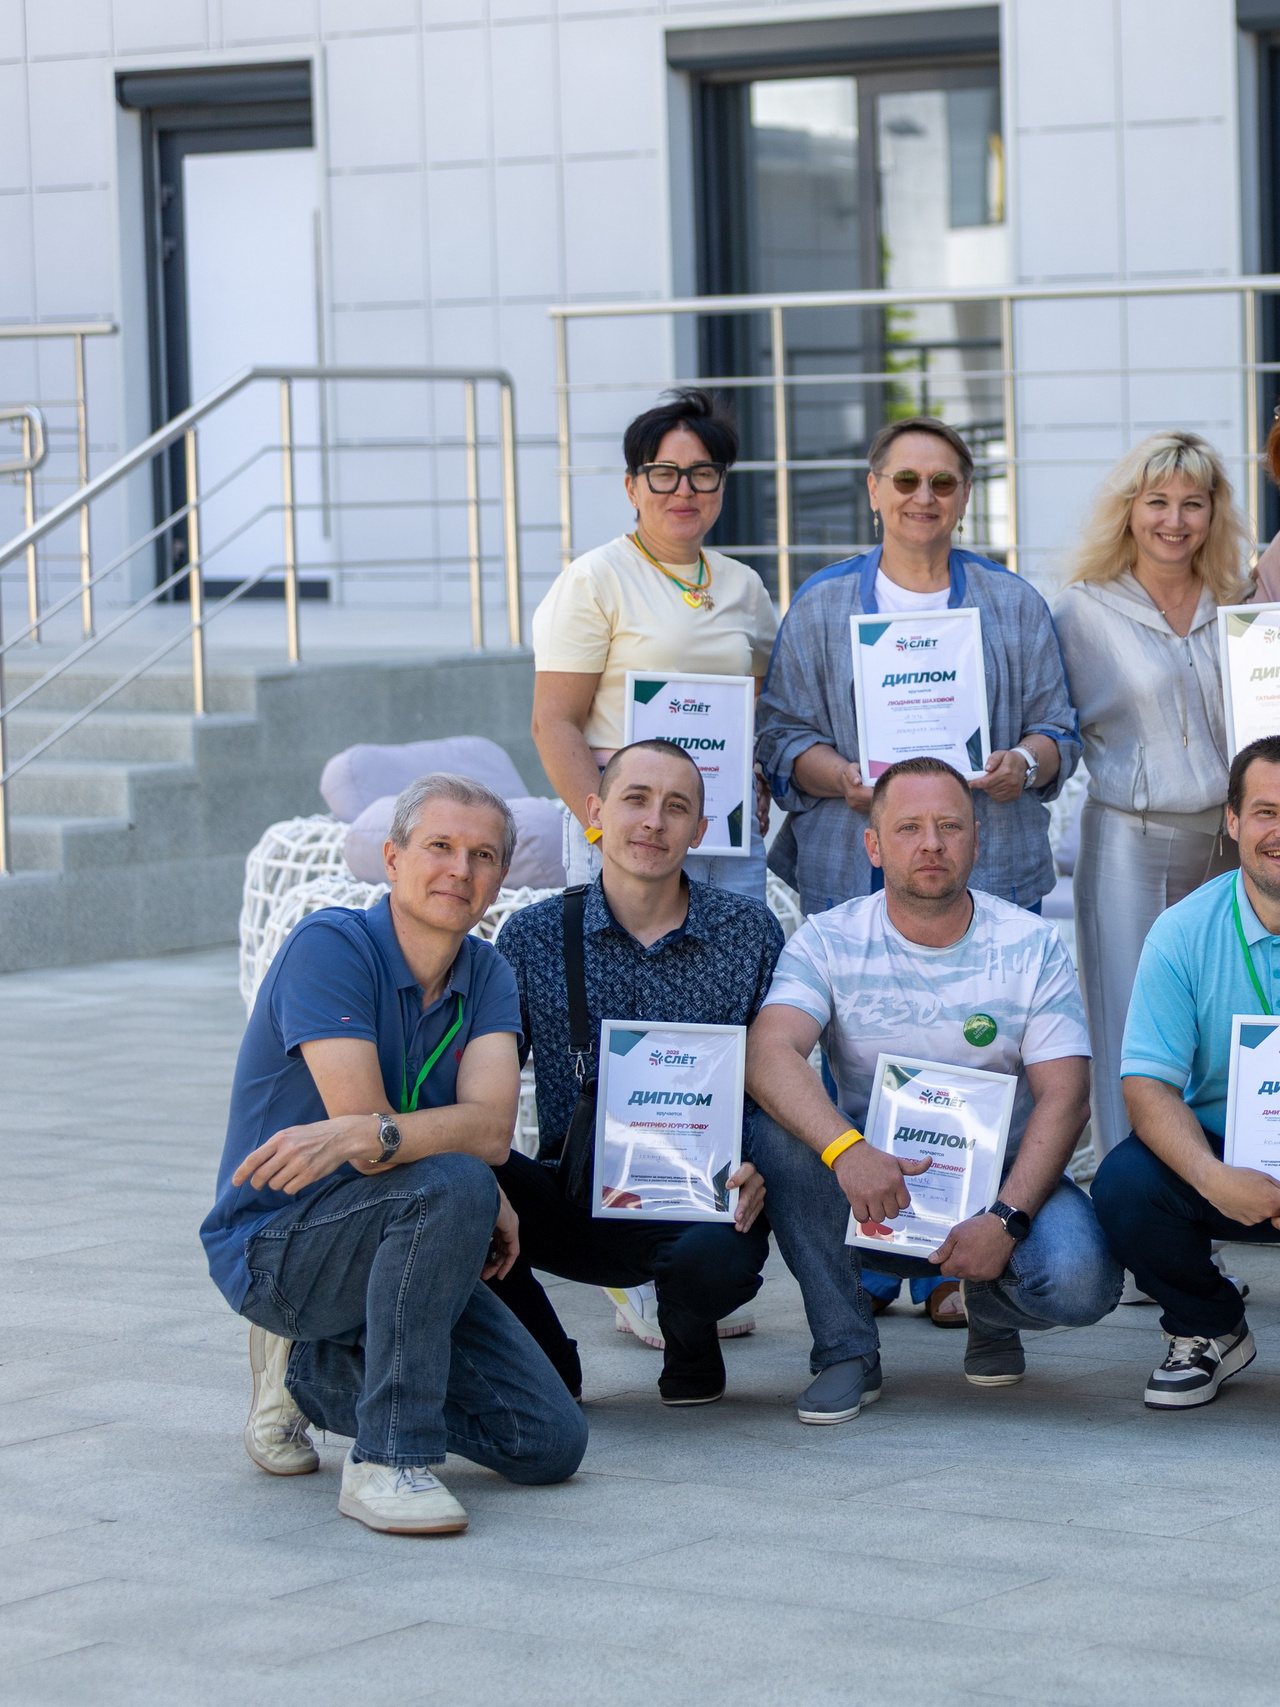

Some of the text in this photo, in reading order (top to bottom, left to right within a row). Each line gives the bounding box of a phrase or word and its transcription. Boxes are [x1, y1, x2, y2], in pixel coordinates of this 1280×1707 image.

[910, 639, 938, 648] СЛЁТ
[882, 670, 956, 688] ДИПЛОМ
[682, 702, 711, 712] СЛЁТ
[664, 1054, 697, 1065] СЛЁТ
[627, 1091, 713, 1106] ДИПЛОМ
[934, 1096, 966, 1108] СЛЁТ
[894, 1126, 976, 1150] ДИПЛОМ
